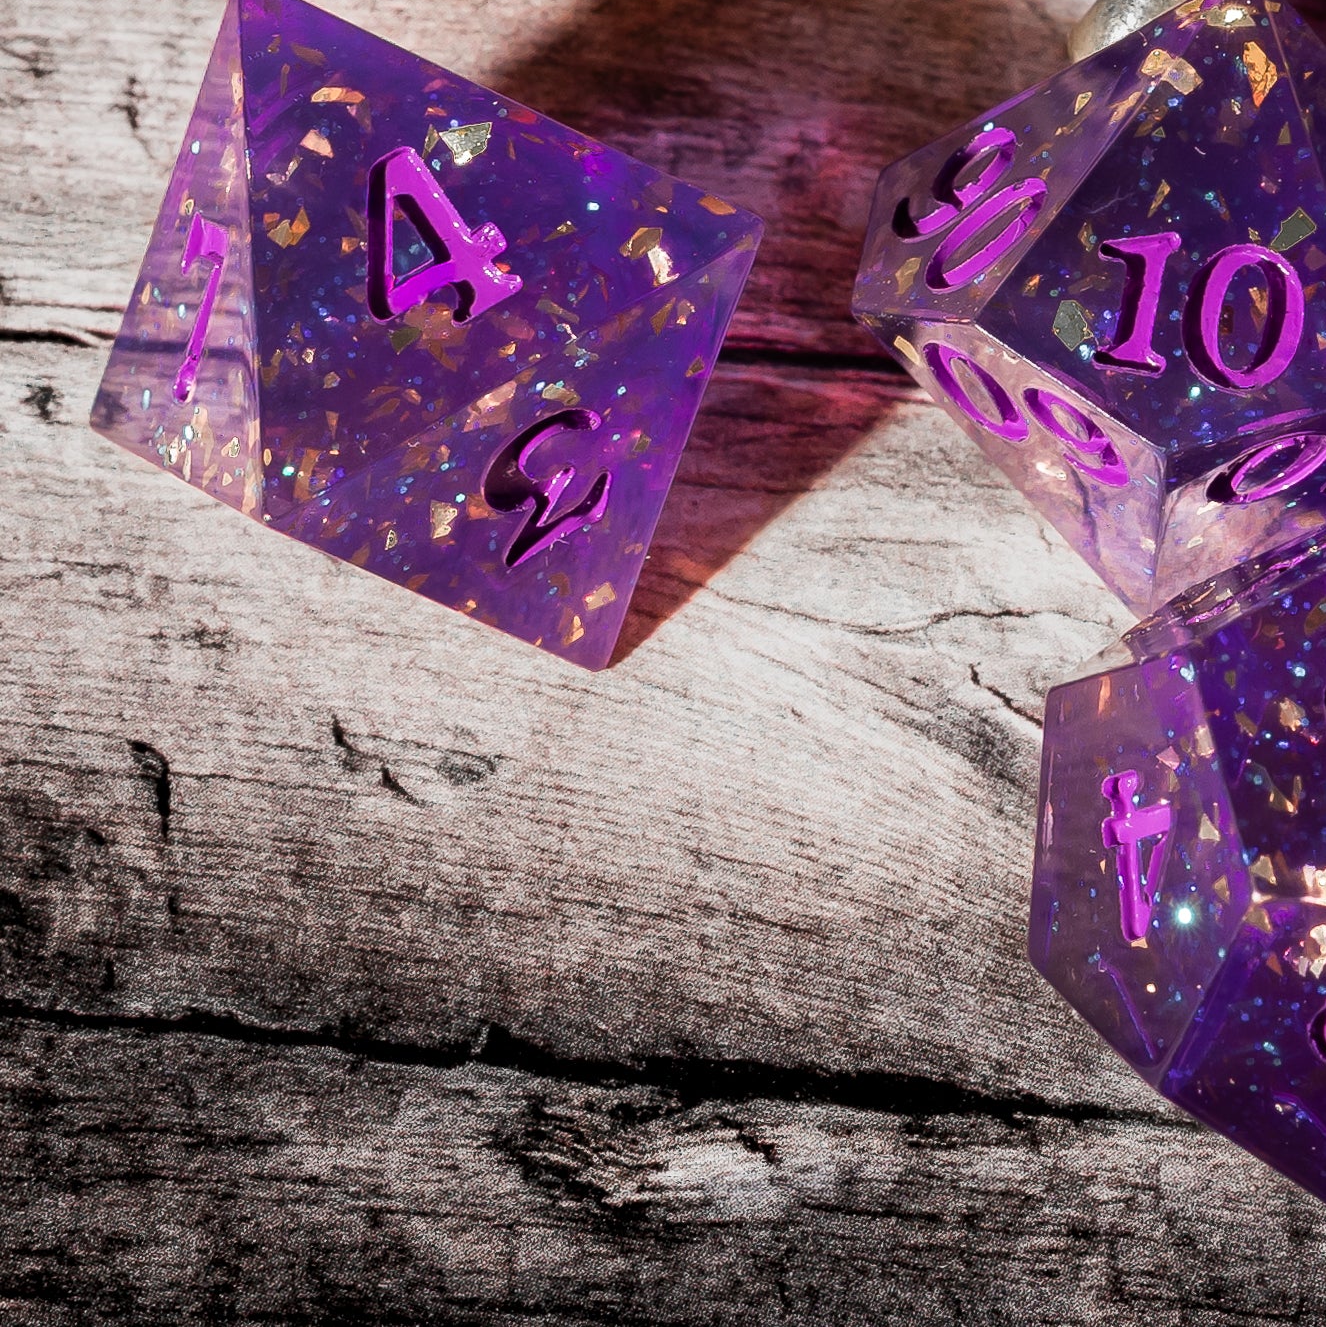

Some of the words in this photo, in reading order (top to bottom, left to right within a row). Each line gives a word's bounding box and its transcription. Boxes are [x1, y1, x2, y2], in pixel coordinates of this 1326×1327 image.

[366, 146, 523, 326] 4
[892, 127, 1048, 294] 90
[1094, 231, 1306, 396] 10
[480, 408, 612, 568] 3
[1102, 770, 1172, 942] 4
